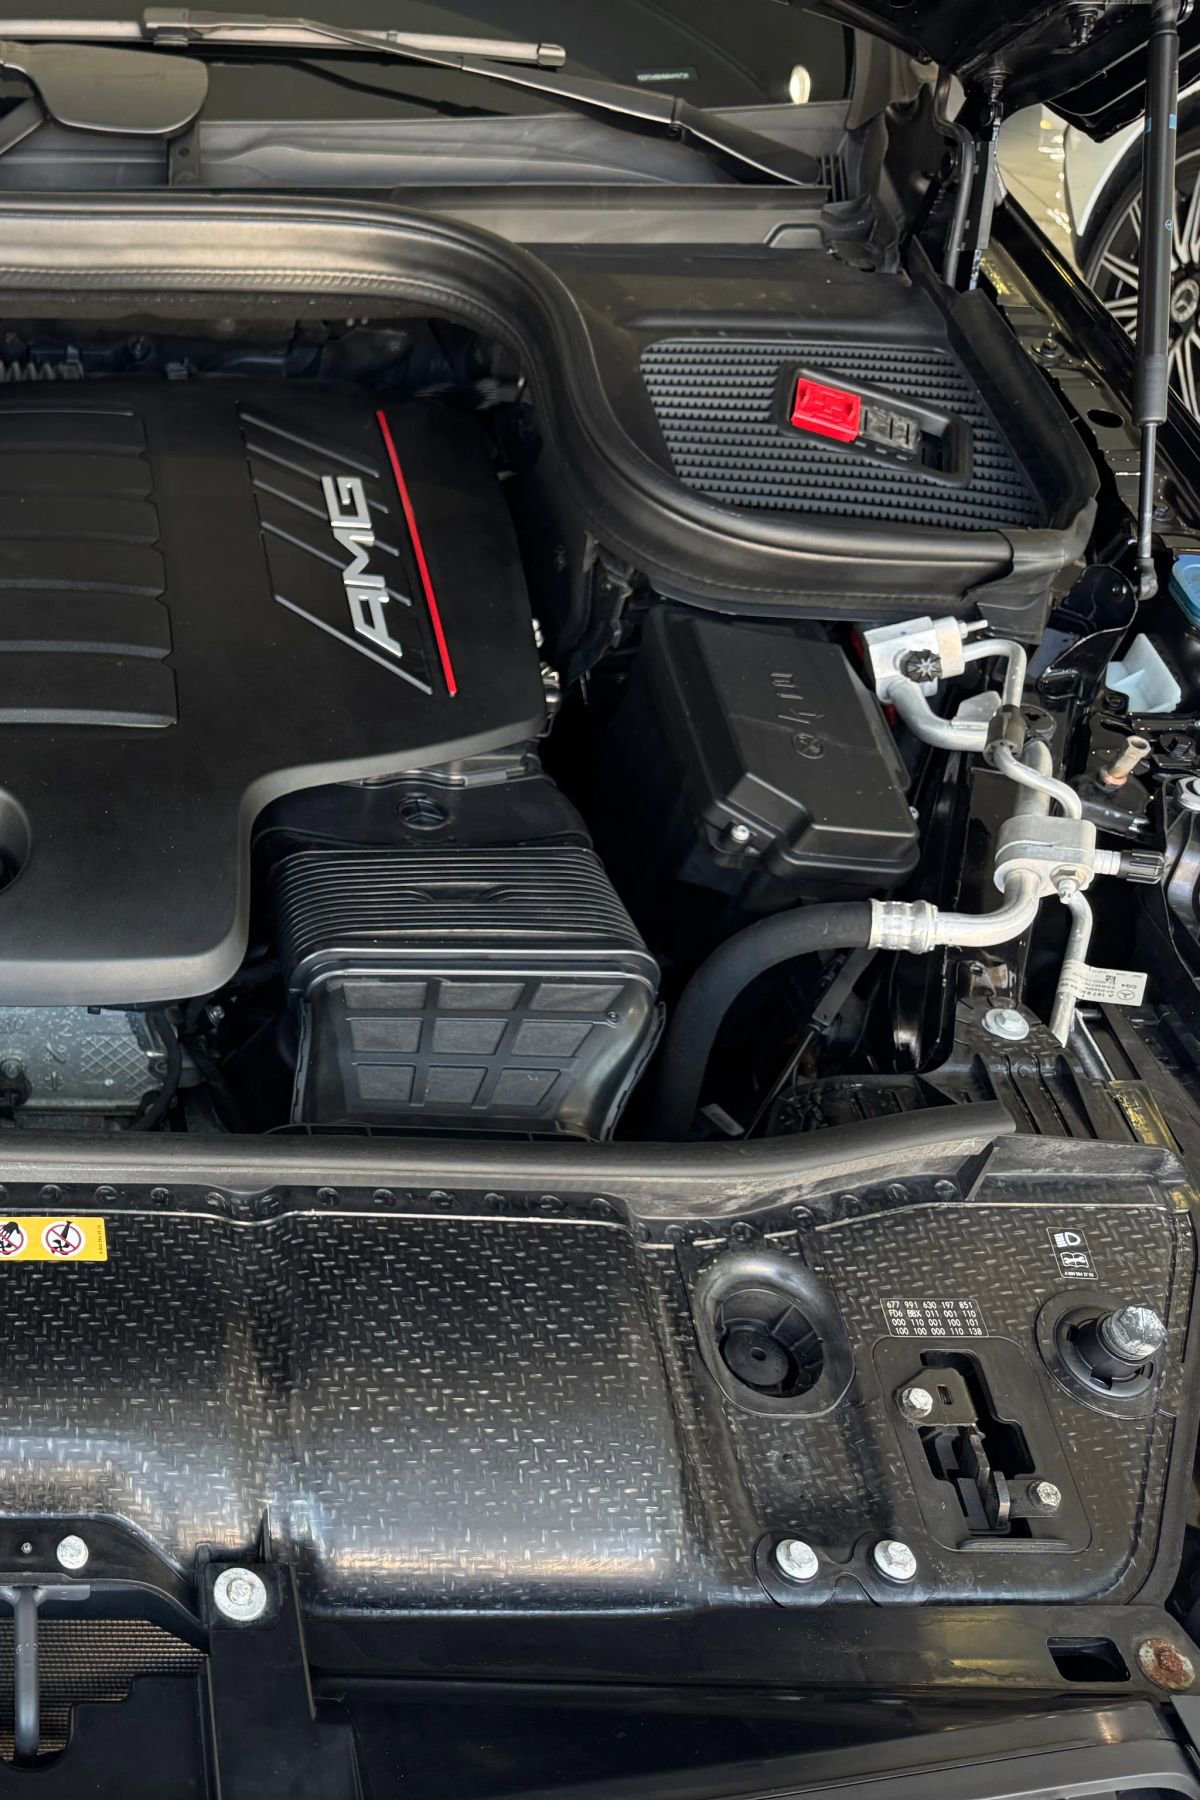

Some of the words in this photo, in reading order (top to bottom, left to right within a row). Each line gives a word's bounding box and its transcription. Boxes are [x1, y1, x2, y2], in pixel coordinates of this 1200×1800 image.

[321, 475, 403, 657] AMG
[887, 1301, 899, 1309] 677
[904, 1301, 918, 1309] 991
[923, 1301, 937, 1309] 630
[941, 1301, 954, 1309] 197
[959, 1301, 973, 1309] 851
[889, 1310, 903, 1318] FD6
[925, 1310, 939, 1318] 011
[943, 1310, 957, 1318] 001
[962, 1310, 976, 1318] 110
[892, 1319, 906, 1327] 000
[911, 1319, 924, 1327] 110
[929, 1319, 942, 1327] 001
[947, 1319, 961, 1327] 100
[966, 1319, 979, 1327] 101
